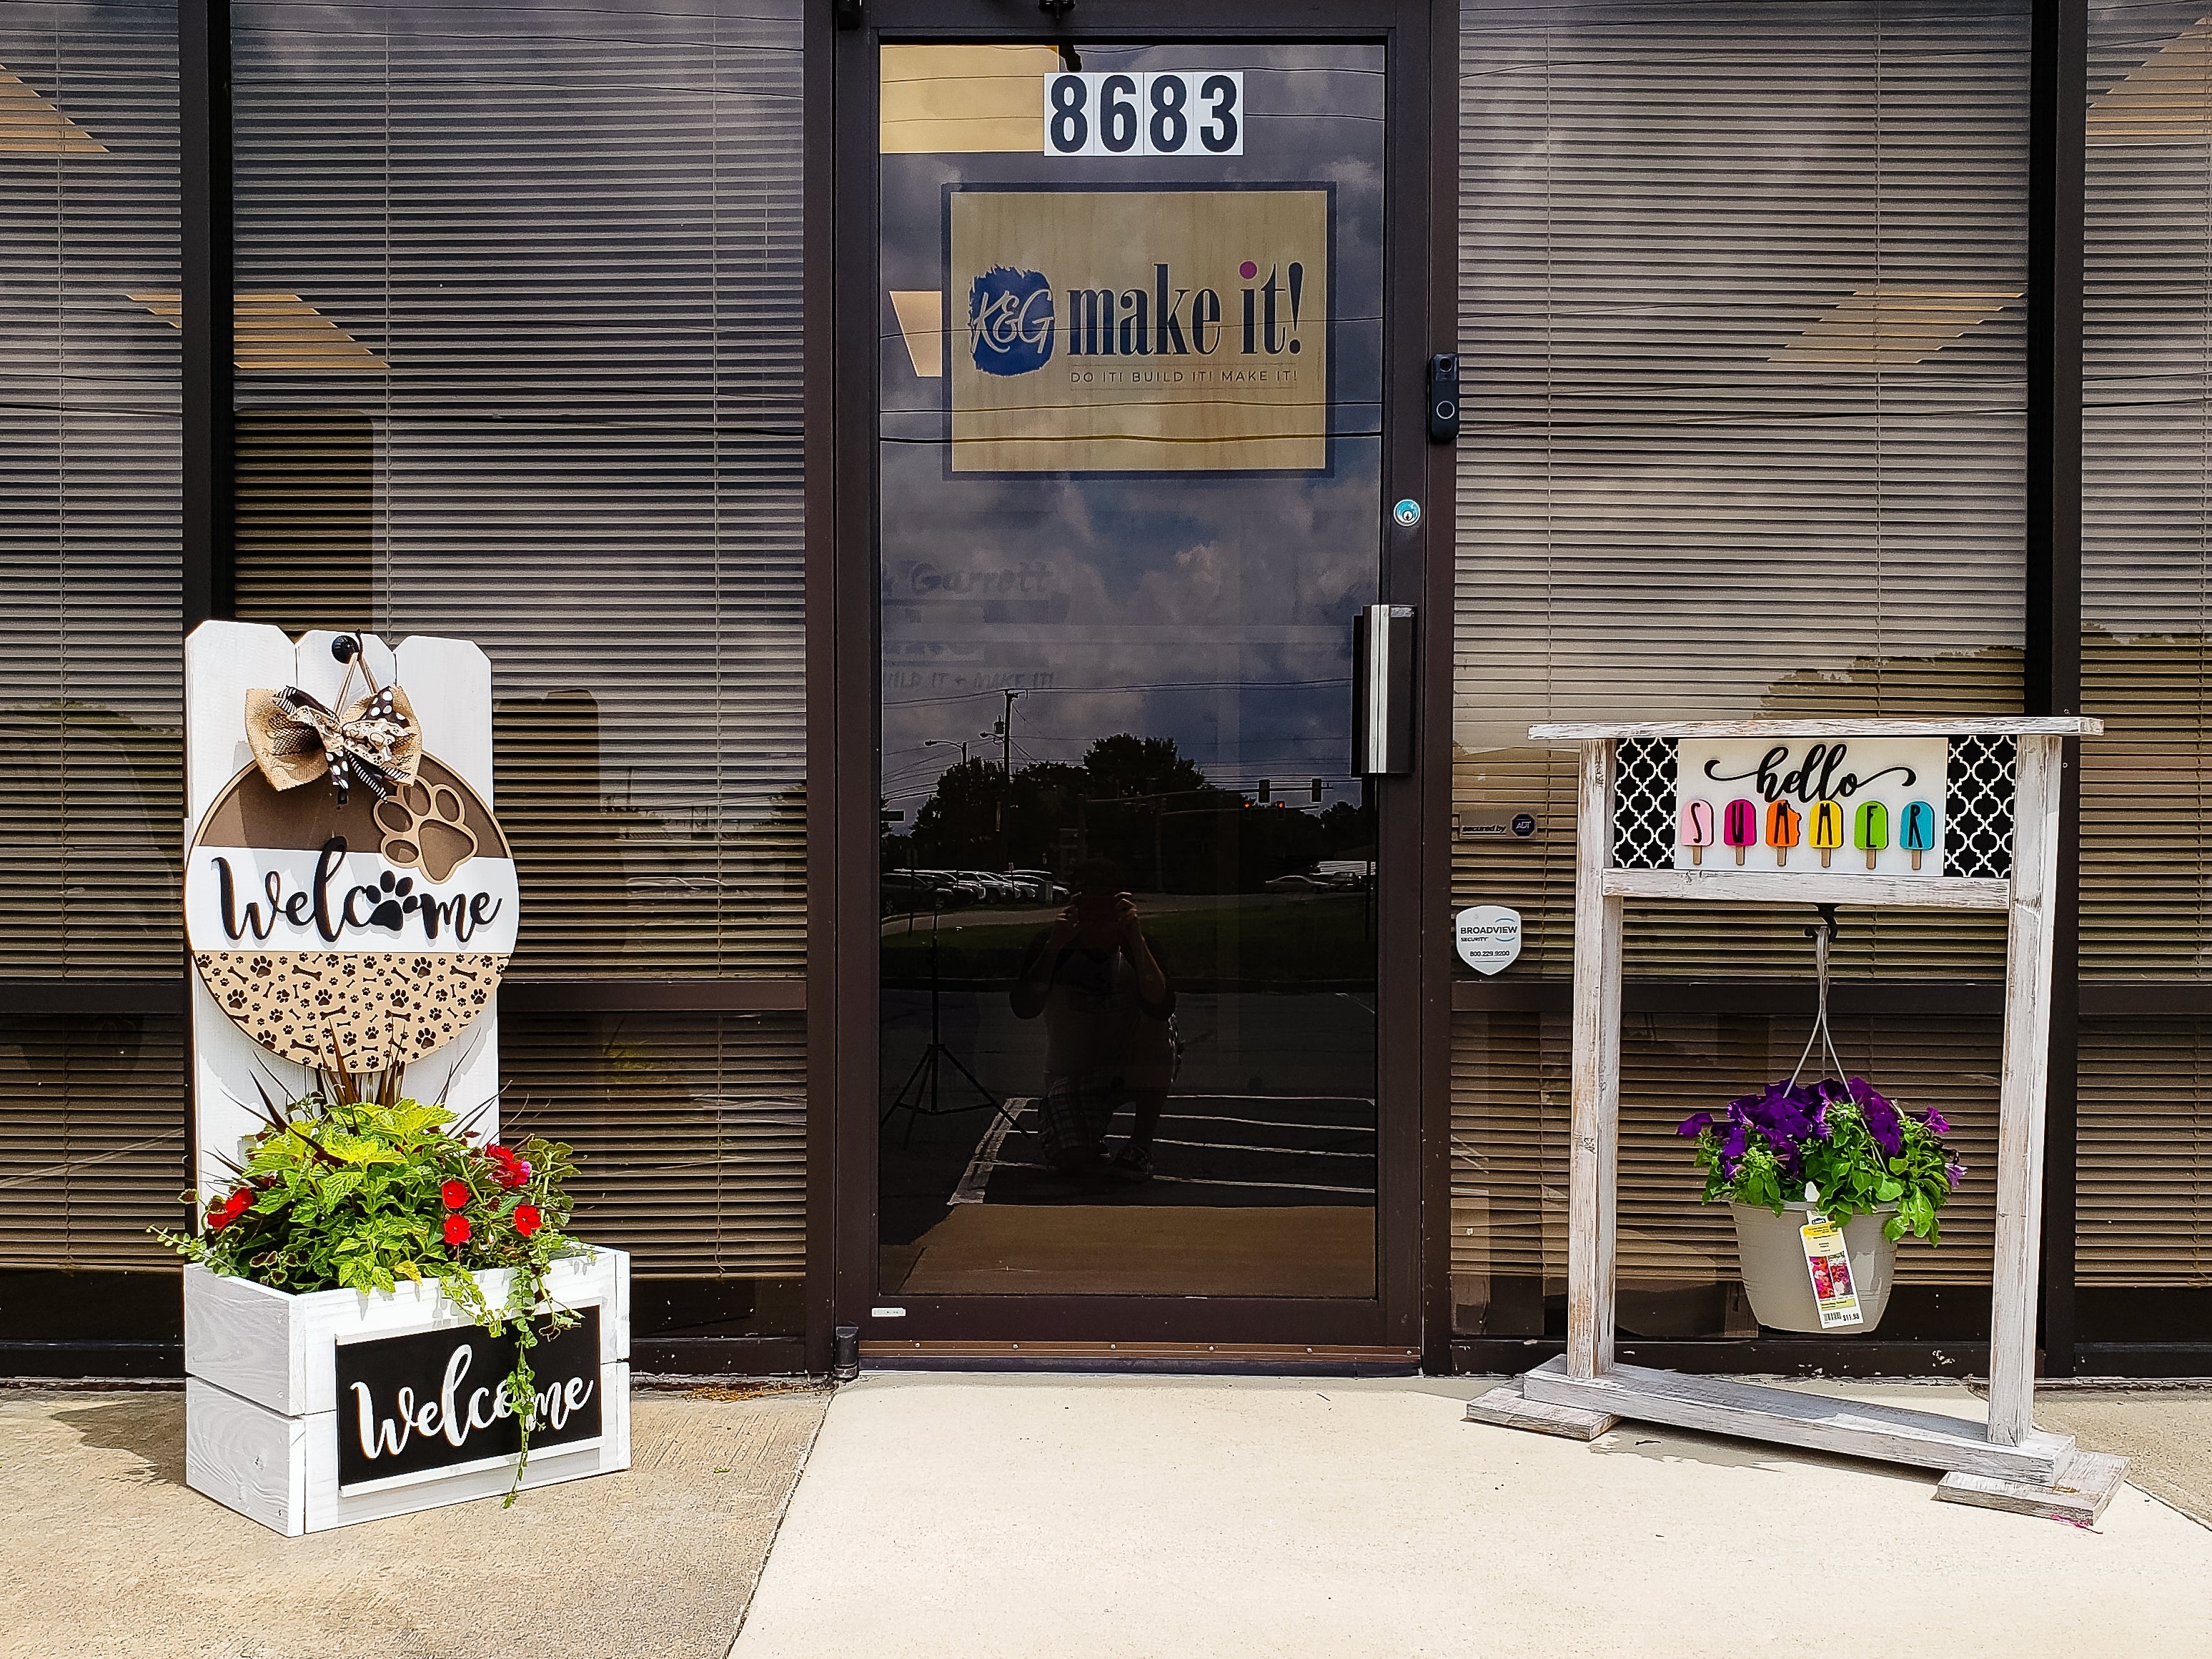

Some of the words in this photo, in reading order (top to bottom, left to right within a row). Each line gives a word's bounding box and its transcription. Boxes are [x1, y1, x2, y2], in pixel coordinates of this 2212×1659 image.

[1050, 74, 1238, 154] 8683
[973, 289, 1055, 355] K&G
[1066, 263, 1221, 356] make
[1239, 260, 1304, 355] it!
[1071, 372, 1094, 383] DO
[1103, 372, 1123, 383] IT!
[1132, 371, 1184, 383] BUILD
[1192, 371, 1213, 382] IT!
[1221, 370, 1268, 382] MAKE
[1276, 370, 1298, 382] IT!
[1703, 743, 1916, 803] hello
[1462, 824, 1495, 833] secured
[1495, 824, 1507, 833] by
[1515, 821, 1532, 829] ADT
[1691, 801, 1923, 850] SUMMER
[212, 836, 502, 943] Welcome
[1460, 926, 1518, 935] BROADVIEW
[349, 1344, 594, 1460] Welcome
